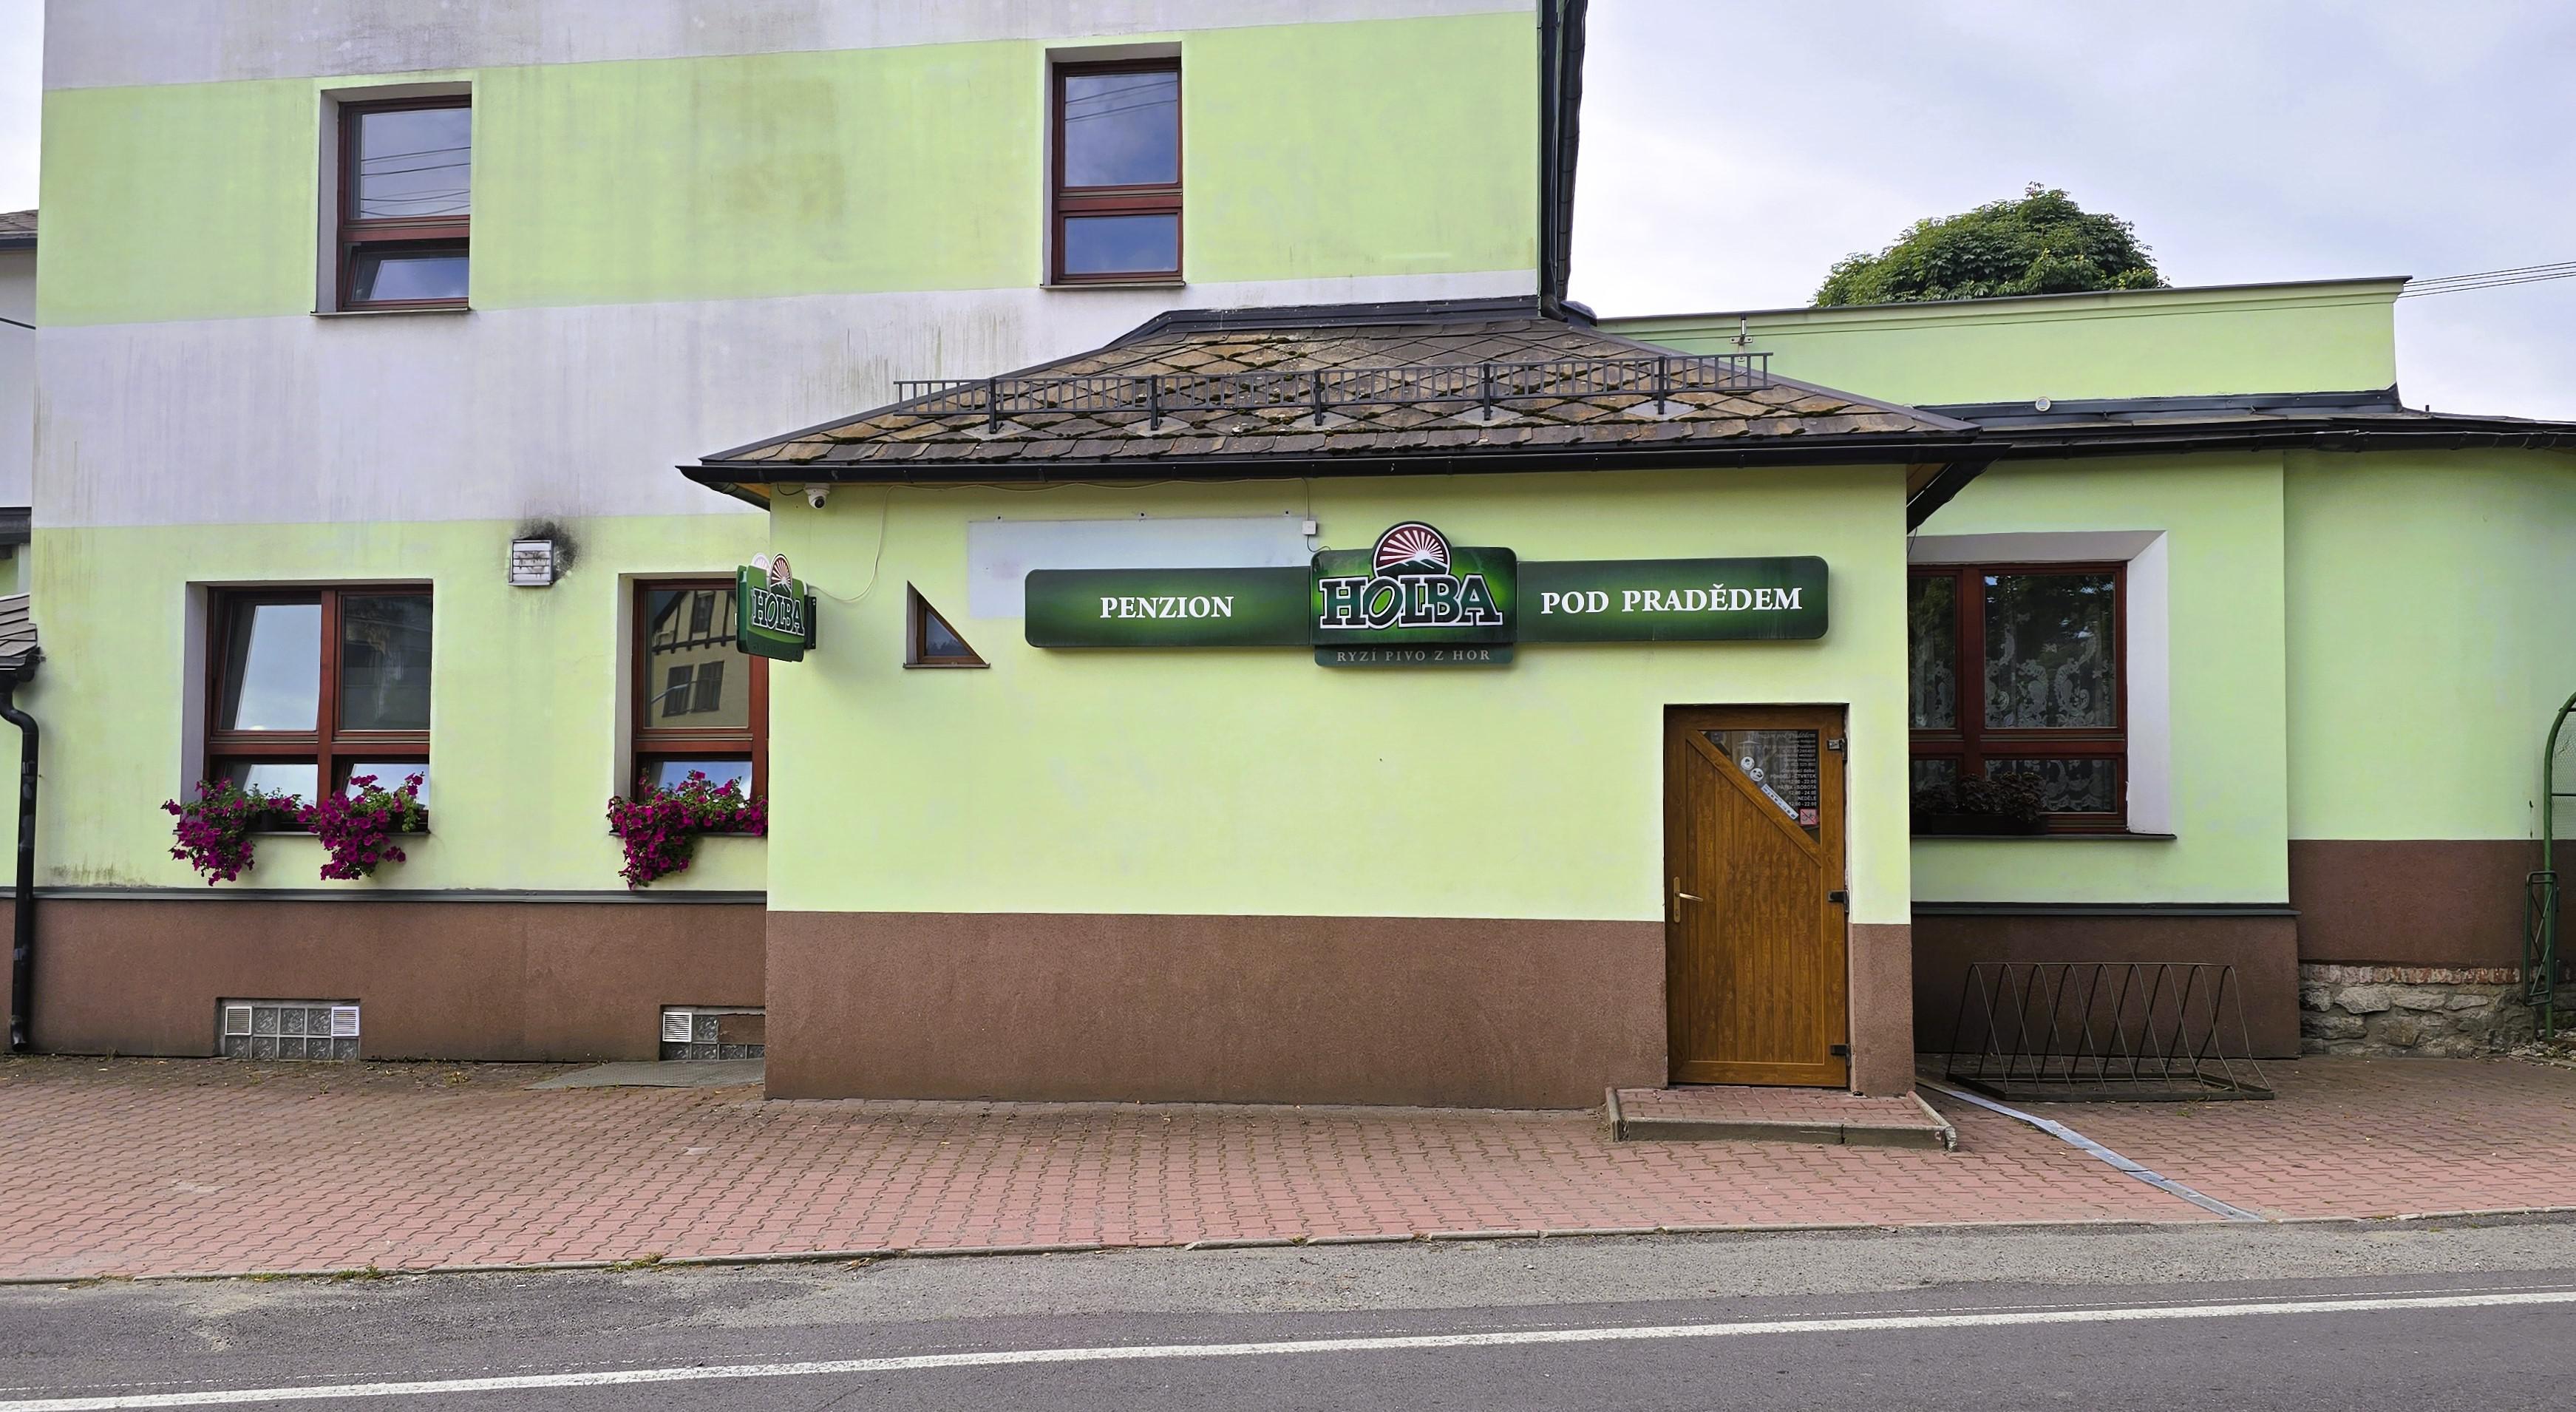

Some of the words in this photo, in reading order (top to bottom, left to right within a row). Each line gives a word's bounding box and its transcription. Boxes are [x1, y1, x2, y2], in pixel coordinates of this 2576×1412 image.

[751, 586, 805, 636] HOLBA
[1100, 596, 1234, 618] PENZION
[1319, 574, 1503, 629] HOLBA
[1540, 591, 1609, 614] POD
[1622, 583, 1802, 612] PRADĚDEM
[1336, 648, 1376, 662] RYZÍ
[1385, 651, 1427, 662] PIVO
[1434, 651, 1444, 661] Z
[1452, 650, 1490, 660] HOR
